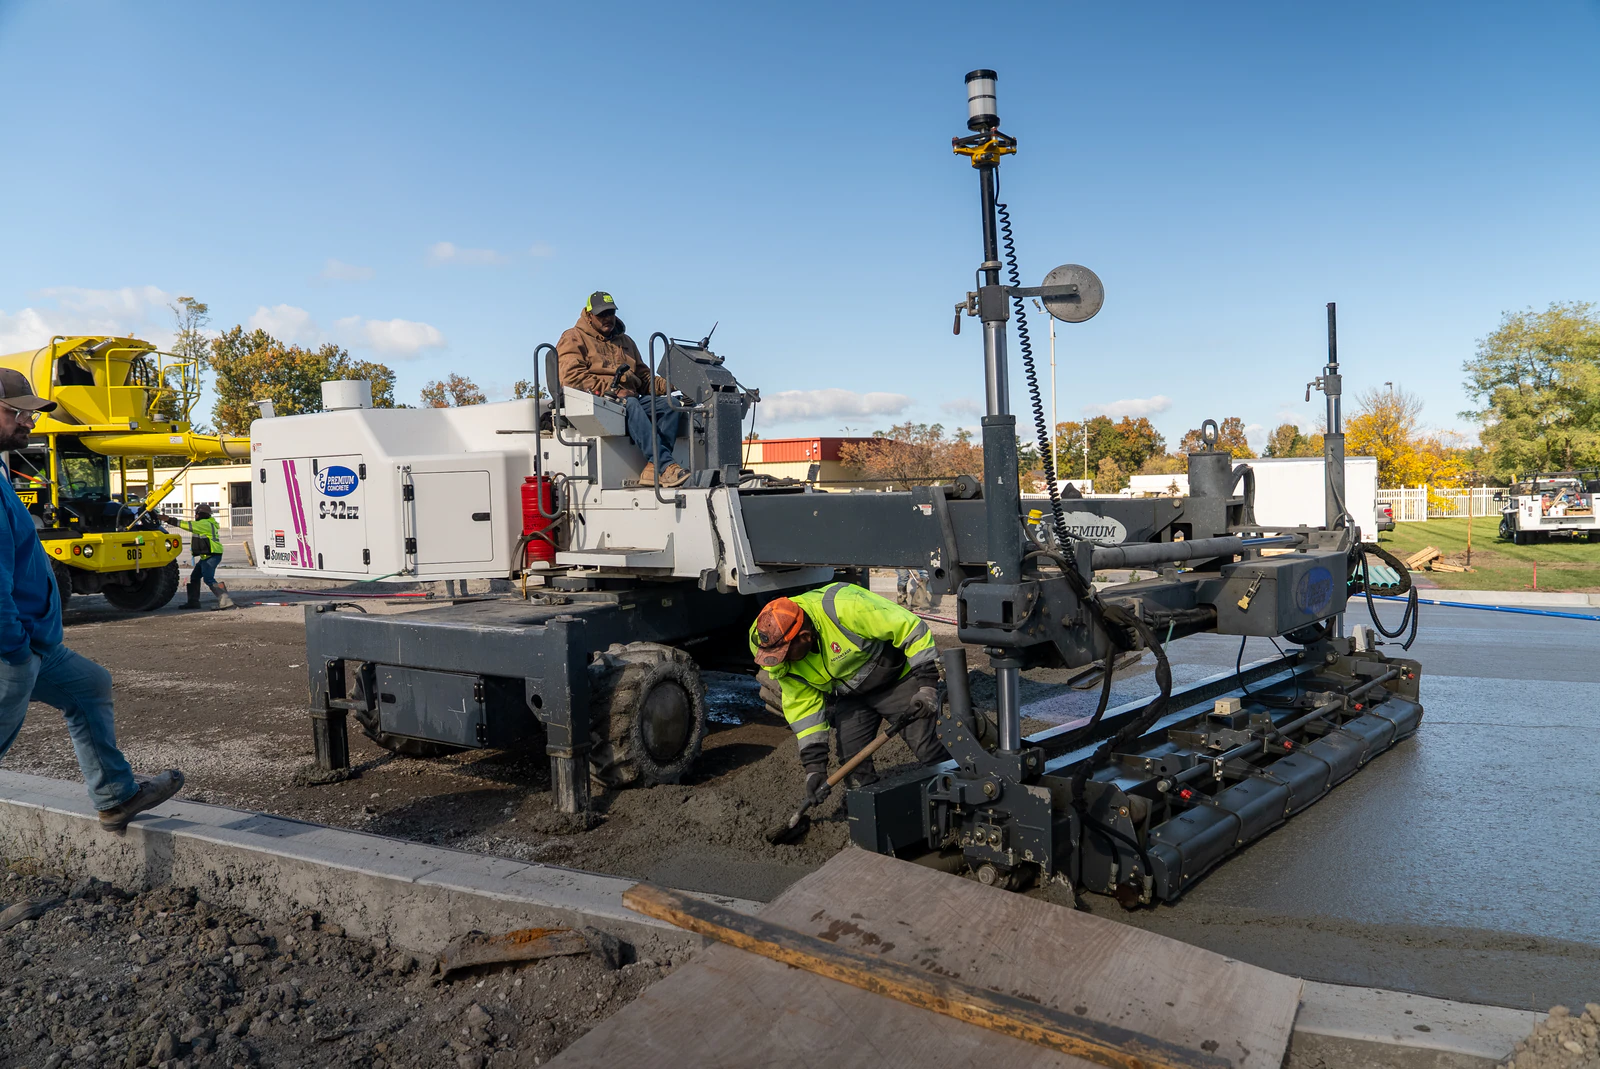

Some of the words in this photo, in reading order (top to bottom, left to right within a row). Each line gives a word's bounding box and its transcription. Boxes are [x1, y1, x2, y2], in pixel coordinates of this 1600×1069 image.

[327, 475, 355, 485] PREMIUM
[1064, 525, 1117, 538] REMIUM
[127, 548, 142, 561] 806
